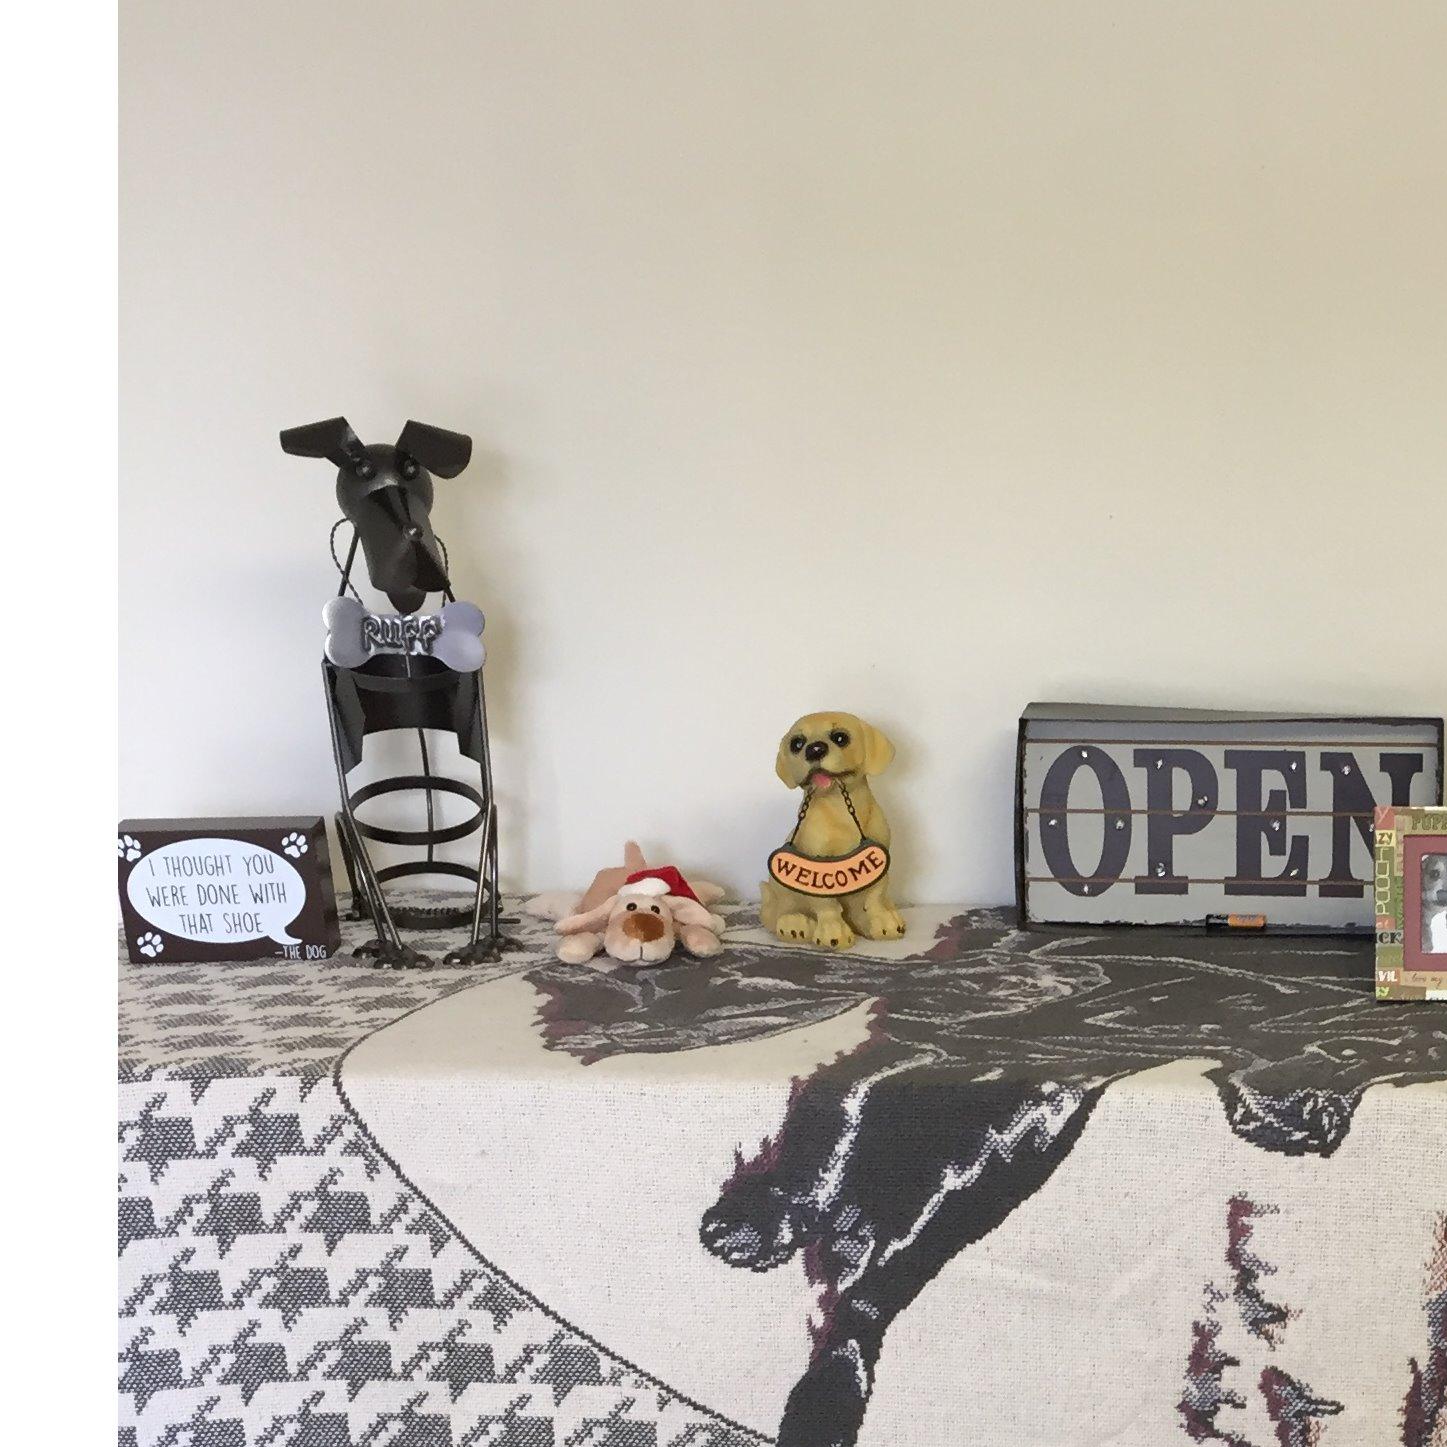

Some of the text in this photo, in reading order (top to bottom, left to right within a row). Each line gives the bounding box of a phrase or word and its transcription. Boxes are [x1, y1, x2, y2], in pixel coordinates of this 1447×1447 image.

[361, 615, 444, 654] RUFF
[1039, 745, 1424, 899] OPEN
[149, 854, 275, 878] I THOUGHT YOU
[776, 850, 884, 890] WELCOME
[146, 882, 287, 908] WERE DONE WITH
[179, 912, 263, 935] THAT SHOE
[305, 944, 327, 959] DOG
